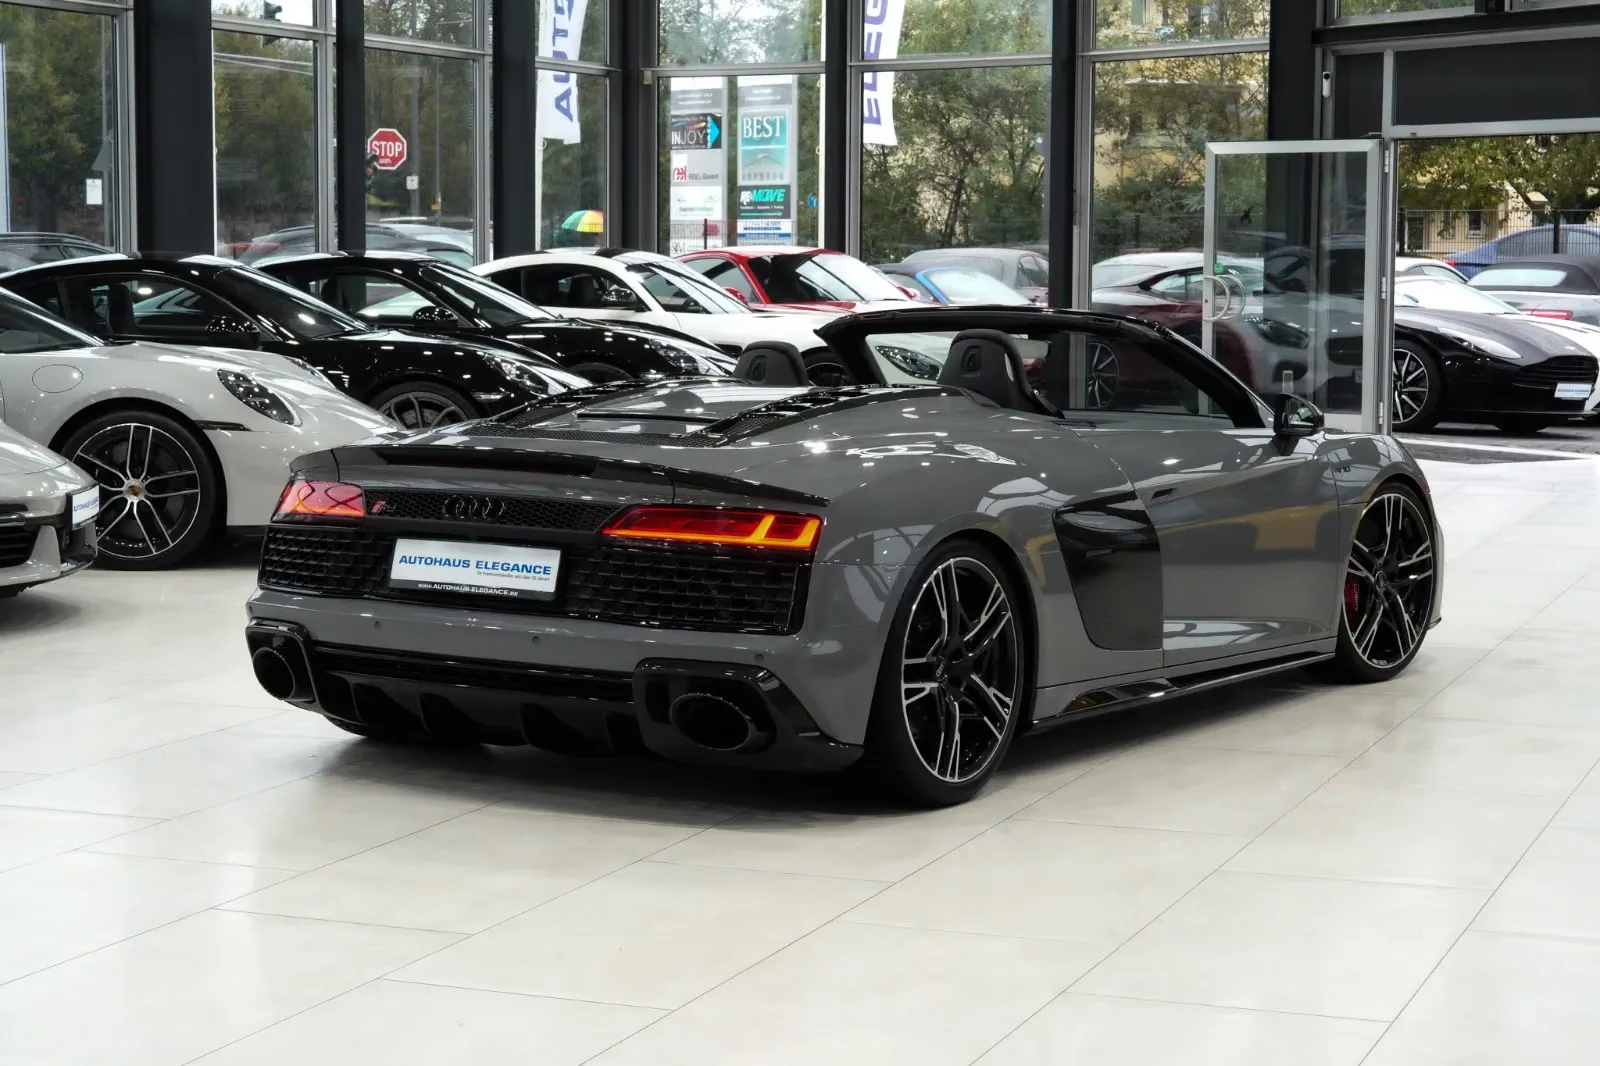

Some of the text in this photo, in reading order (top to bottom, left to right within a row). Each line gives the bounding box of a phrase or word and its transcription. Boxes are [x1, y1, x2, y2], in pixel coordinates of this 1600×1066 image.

[743, 115, 784, 138] BEST
[671, 130, 706, 145] INJOY
[371, 140, 402, 157] STOP
[399, 555, 552, 575] AUTOHAUS ELEGANCE
